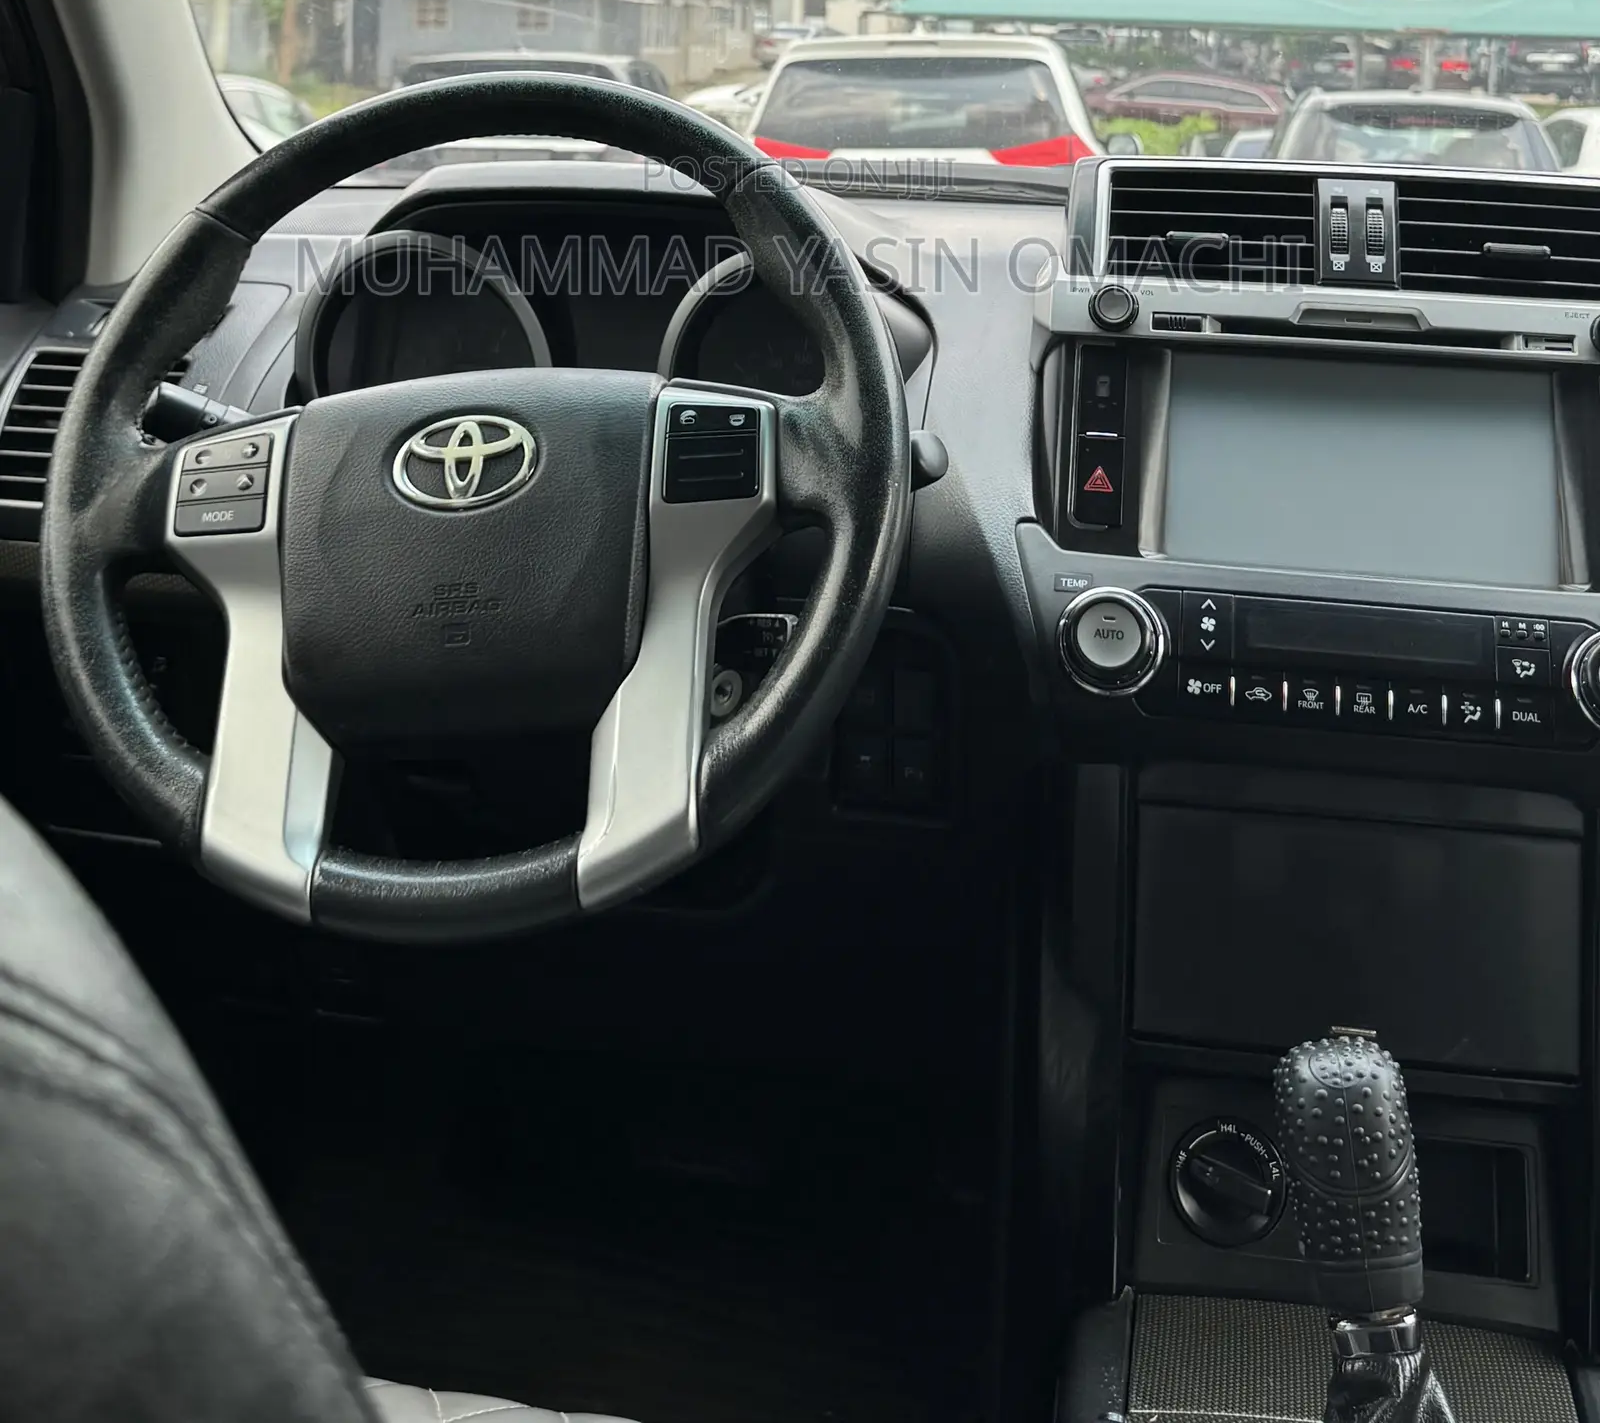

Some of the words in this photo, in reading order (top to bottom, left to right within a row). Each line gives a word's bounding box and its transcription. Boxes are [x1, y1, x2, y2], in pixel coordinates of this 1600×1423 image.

[202, 510, 235, 523] MODE
[1060, 577, 1088, 588] TEMP
[432, 582, 480, 598] SRS
[411, 599, 503, 618] AIRBAG
[1518, 622, 1526, 630] M
[1093, 628, 1125, 641] AUTO
[1202, 683, 1222, 694] OFF
[1297, 700, 1324, 710] FRONT
[1353, 704, 1376, 714] REAR
[1407, 704, 1428, 714] A/C
[1512, 710, 1541, 723] DUAL
[1220, 1123, 1238, 1134] H4L
[1269, 1161, 1280, 1181] L4L
